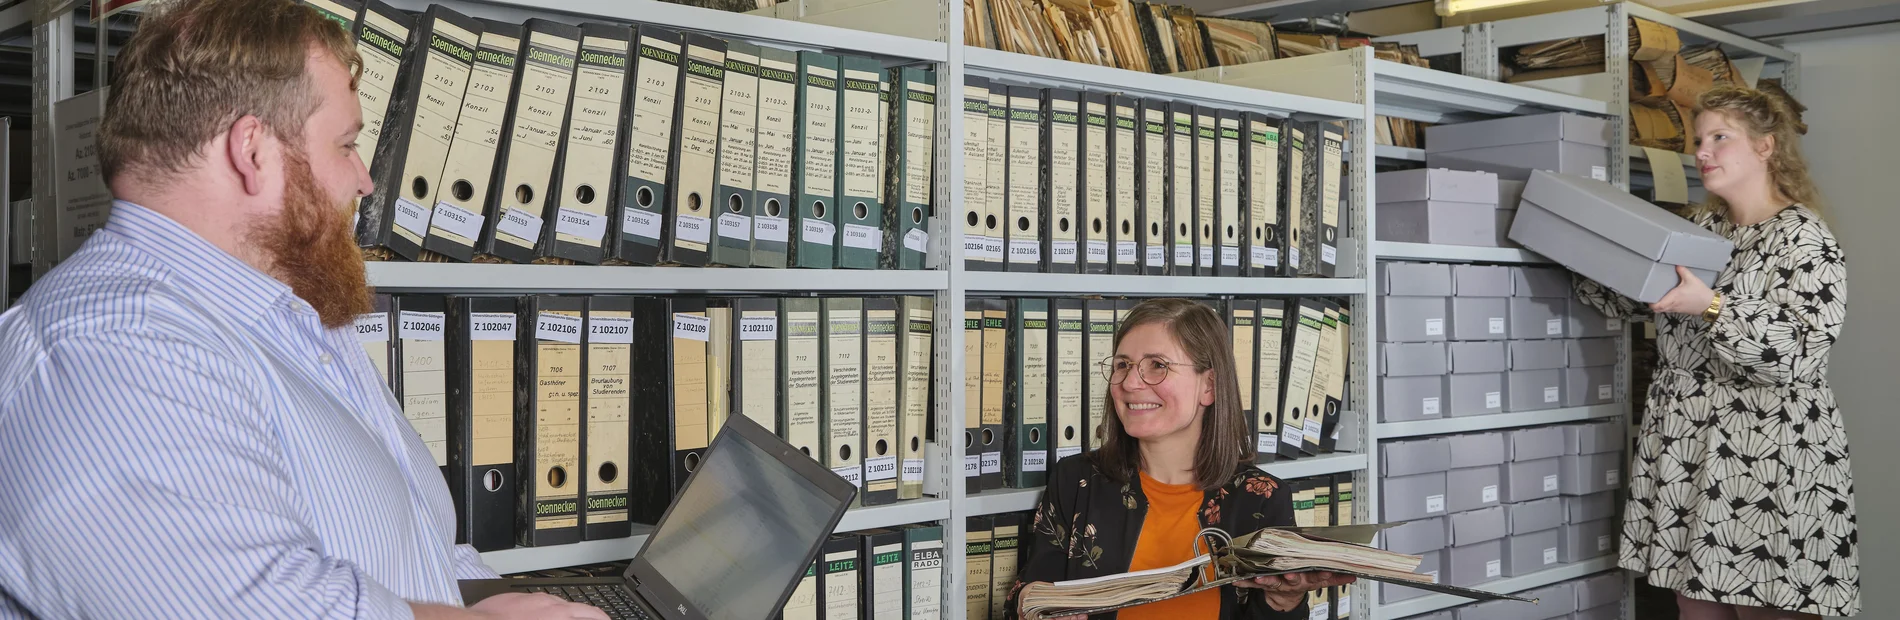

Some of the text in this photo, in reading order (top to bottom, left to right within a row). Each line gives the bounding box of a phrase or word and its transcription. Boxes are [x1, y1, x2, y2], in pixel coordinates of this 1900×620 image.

[361, 26, 403, 58] Soennecken
[431, 34, 473, 63] Soennecken
[475, 50, 515, 67] ennecken
[529, 48, 574, 68] Soennecken
[581, 50, 625, 67] Soennecken
[641, 46, 679, 64] SOENNECKEN
[688, 61, 723, 79] Soennecken
[725, 60, 758, 75] SOENNECKEN
[364, 67, 385, 82] 2103
[761, 68, 794, 82] SOENNECKEN
[434, 74, 454, 87] 2103
[646, 77, 665, 87] 2103
[807, 75, 836, 88] SOENNECKEN
[474, 83, 495, 93] 2103
[535, 85, 556, 95] 2103
[588, 86, 609, 95] 2103
[846, 81, 878, 92] SOENNECKEN
[426, 93, 446, 107] Konzil
[643, 95, 662, 106] Konzil
[695, 96, 711, 106] 2103
[908, 91, 934, 103] SOENNECKEN
[465, 102, 489, 113] Konzil
[810, 102, 824, 110] 2103
[850, 106, 864, 115] 2103
[528, 106, 553, 117] Konzil
[582, 107, 607, 117] Konzil
[729, 108, 746, 117] Konzil
[1010, 109, 1039, 120] Soennecken
[1053, 111, 1077, 122] Soennecken
[692, 117, 712, 127] Konzil
[766, 115, 782, 123] Konzil
[525, 125, 547, 135] Januar
[581, 126, 602, 135] Januar
[812, 135, 827, 143] Januar
[1325, 139, 1340, 149] ELBA
[397, 204, 420, 220] Z 103151
[438, 207, 468, 224] Z 103152
[508, 214, 528, 227] 103153
[561, 214, 590, 226] Z 103154
[632, 216, 650, 226] 103156
[720, 218, 741, 229] Z 103157
[683, 221, 700, 230] 103155
[757, 222, 778, 231] Z 103158
[809, 225, 824, 235] 103159
[850, 230, 867, 239] 103160
[986, 244, 1001, 252] 02165
[403, 321, 440, 332] Z 102046
[474, 322, 512, 331] Z 102047
[540, 322, 577, 334] Z 102106
[599, 326, 629, 334] 102107
[676, 322, 706, 333] Z 102109
[868, 323, 896, 332] Soennecken
[1058, 321, 1082, 330] Soennecken
[1090, 323, 1113, 332] Soennecken
[539, 379, 566, 387] Gasthörer
[873, 463, 894, 473] 102113
[536, 501, 577, 514] Soennecken
[588, 496, 627, 509] Soennecken
[966, 543, 991, 553] Soennecken
[994, 538, 1018, 548] Soennecken
[876, 552, 899, 563] LEITZ
[914, 550, 939, 560] ELBA
[829, 561, 854, 571] LEITZ
[677, 604, 688, 615] DELL
